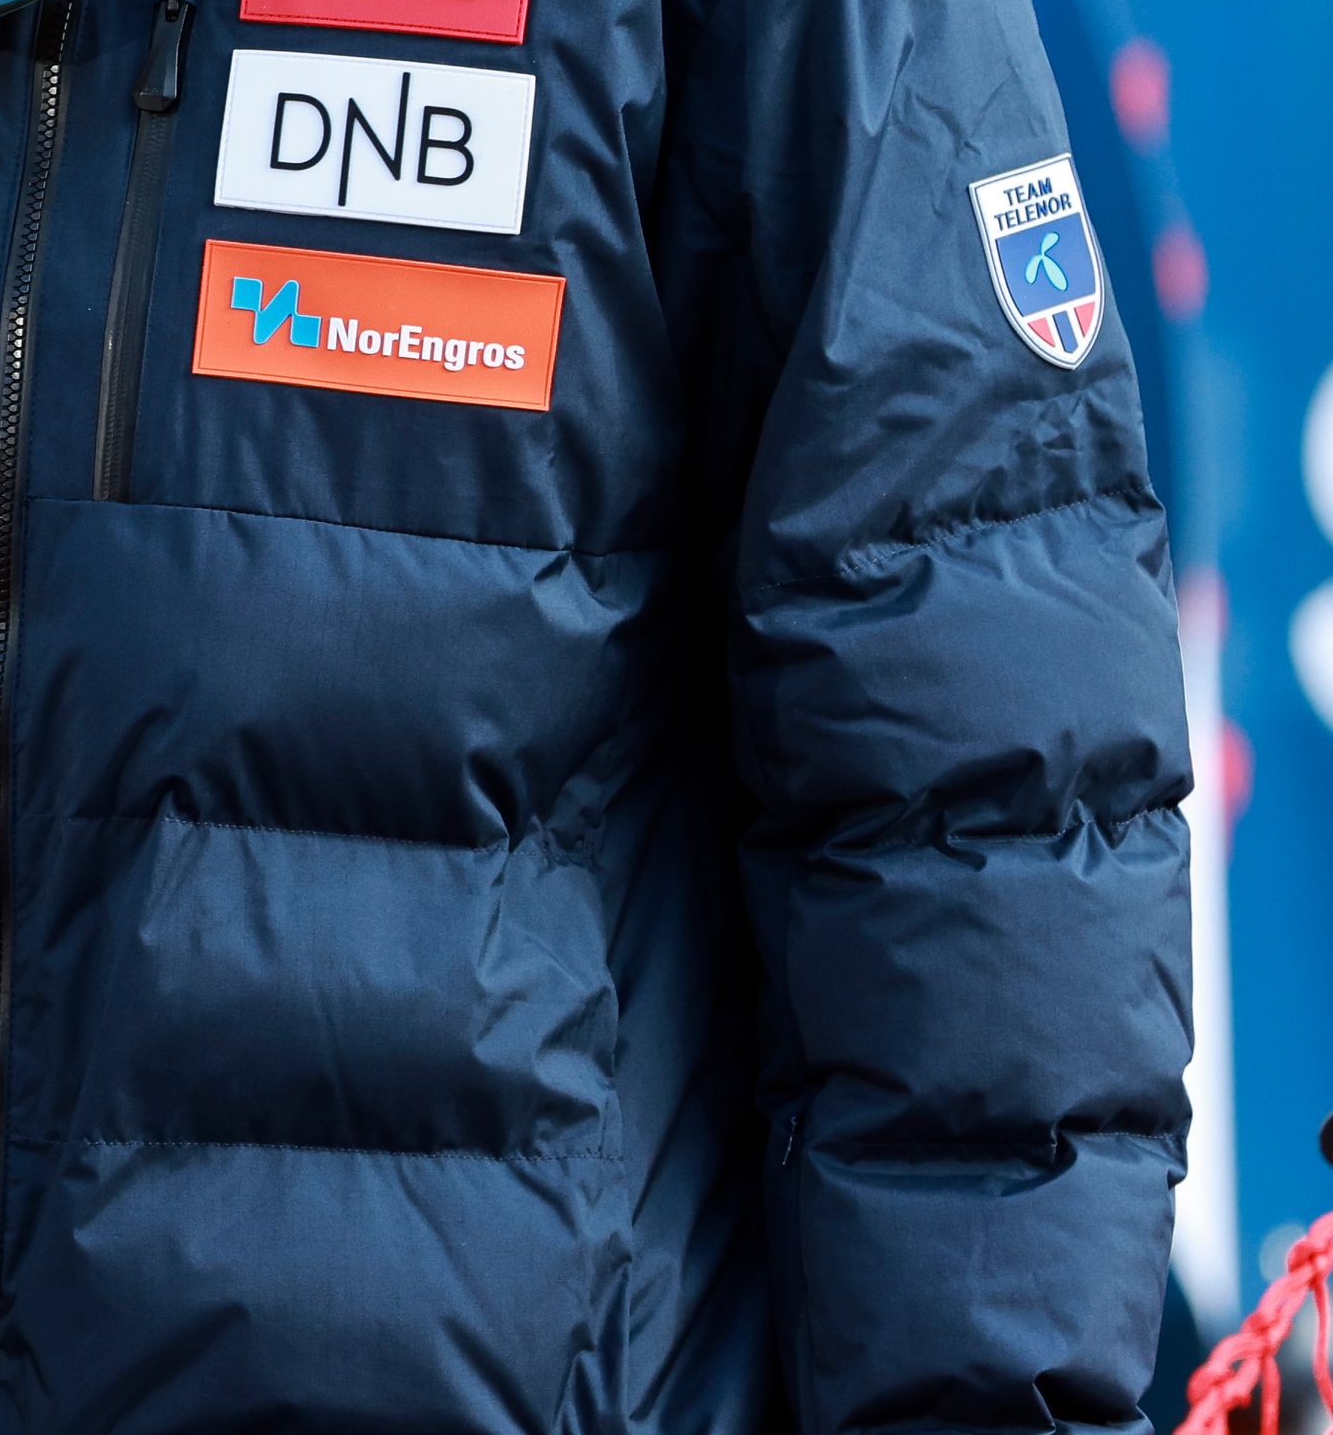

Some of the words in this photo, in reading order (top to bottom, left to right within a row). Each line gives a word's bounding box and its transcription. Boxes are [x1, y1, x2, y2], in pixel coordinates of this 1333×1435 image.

[269, 71, 476, 207] DNB
[993, 193, 1072, 231] TELENOR
[1003, 177, 1053, 206] TEAM
[326, 317, 526, 371] NorEngros
